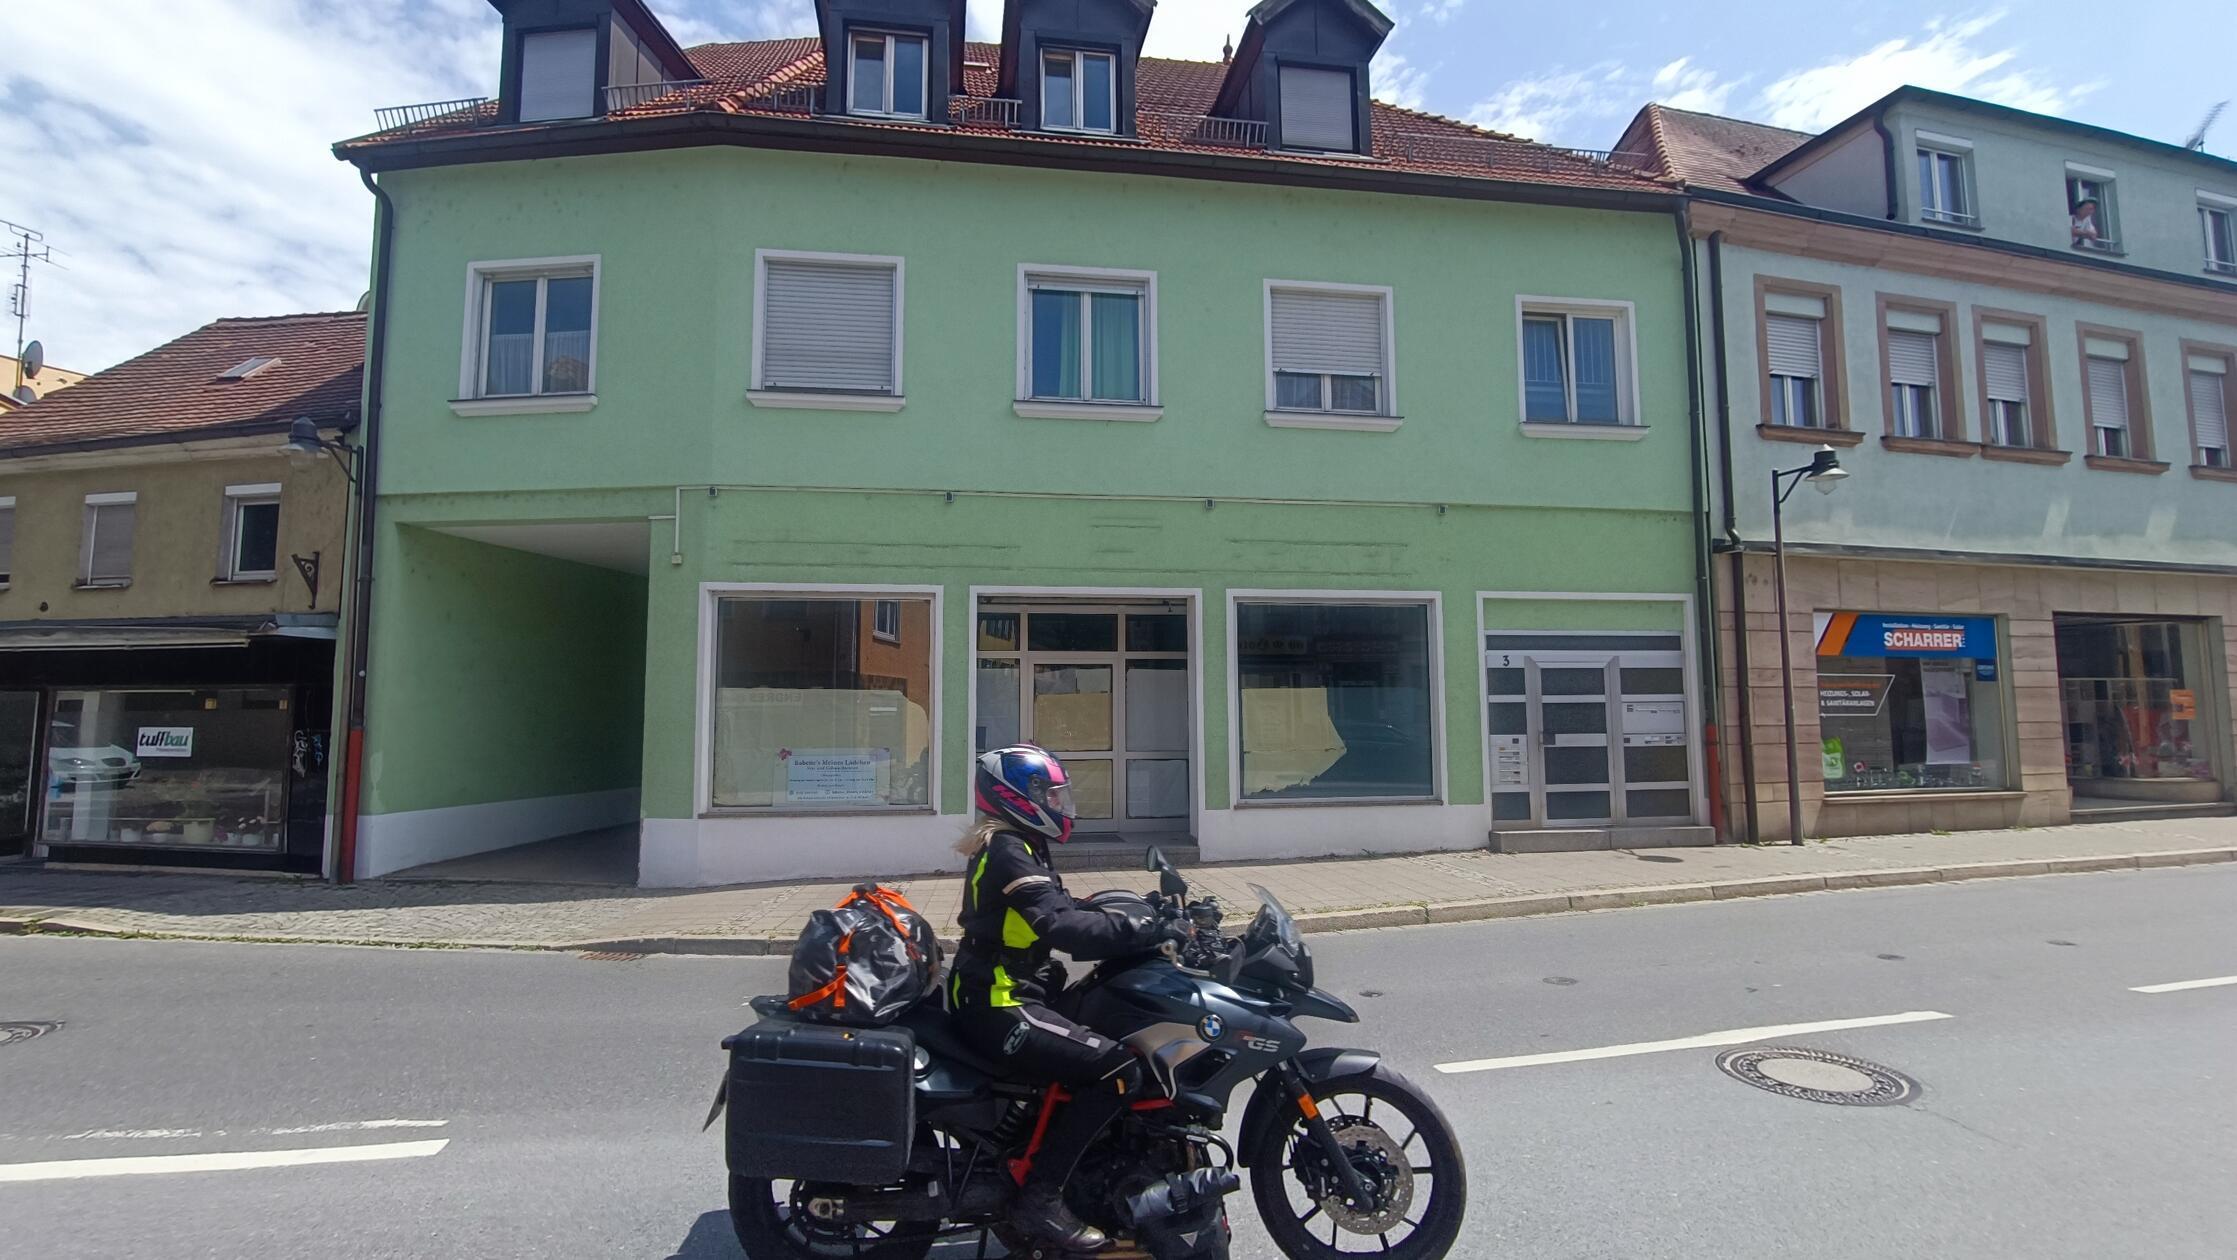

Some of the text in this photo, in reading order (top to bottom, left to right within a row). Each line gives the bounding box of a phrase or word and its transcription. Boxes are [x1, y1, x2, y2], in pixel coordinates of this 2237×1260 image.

[1884, 632, 1961, 648] SCHARRER
[1502, 655, 1510, 667] 3
[139, 731, 189, 746] tuffbau
[1247, 1036, 1280, 1053] GS
